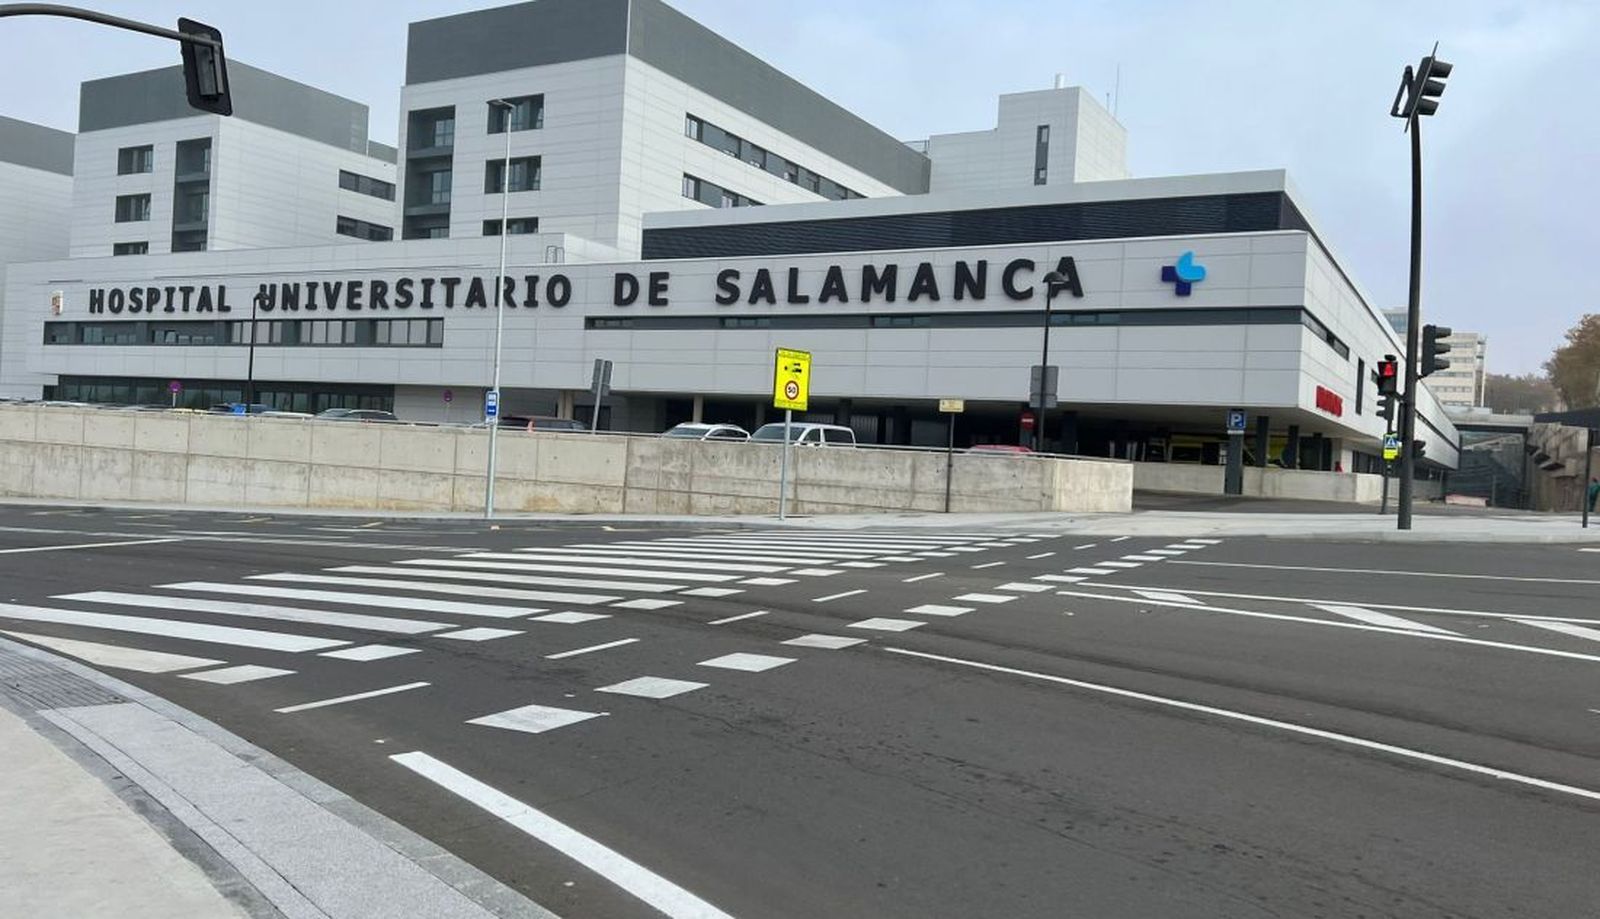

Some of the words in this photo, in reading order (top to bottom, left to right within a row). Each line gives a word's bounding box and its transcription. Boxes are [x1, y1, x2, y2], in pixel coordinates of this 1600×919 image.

[89, 285, 231, 314] HOSPITAL
[259, 274, 572, 312] UNIVERSITARIO
[613, 271, 670, 307] DE
[715, 256, 1084, 306] SALAMANCA
